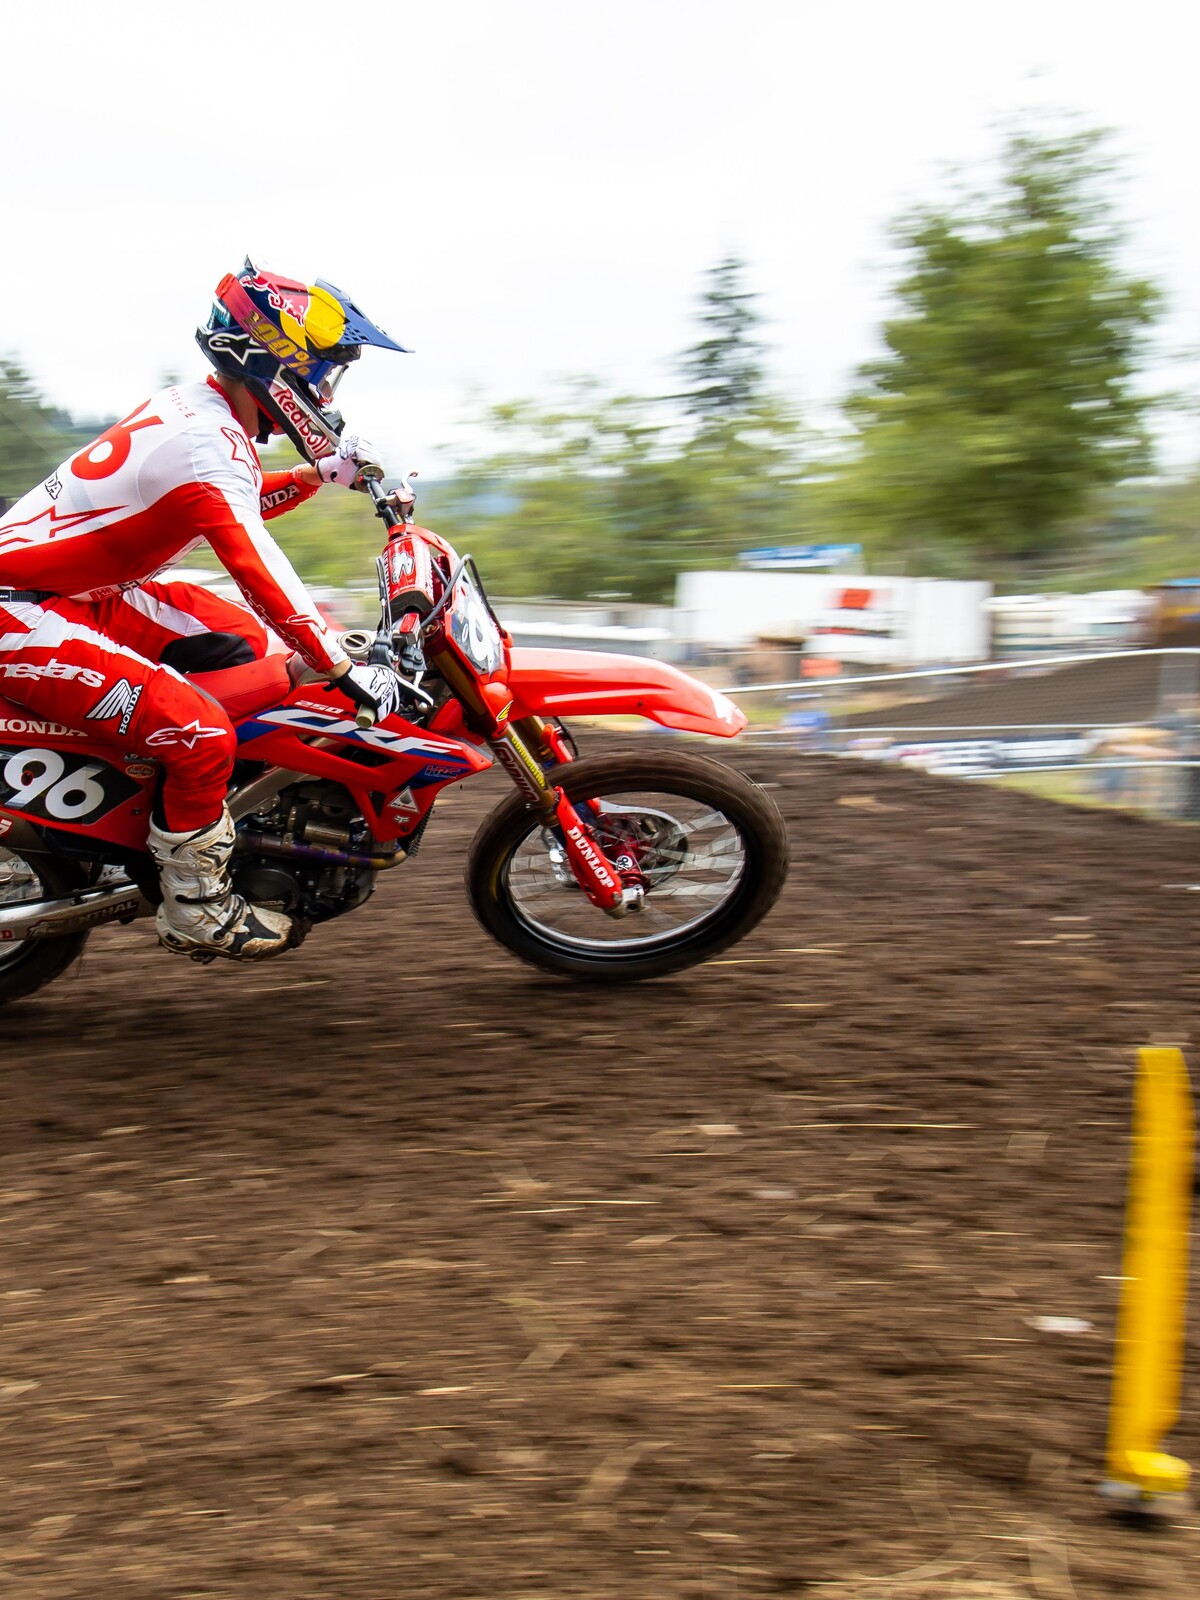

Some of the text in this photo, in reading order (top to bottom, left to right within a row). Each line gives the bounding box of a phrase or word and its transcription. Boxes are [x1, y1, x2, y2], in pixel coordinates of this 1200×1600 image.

[274, 389, 311, 429] Red
[71, 399, 164, 481] 6
[260, 484, 301, 512] NDA
[119, 684, 142, 735] HONDA
[294, 700, 344, 714] 250
[3, 748, 105, 819] 96
[566, 825, 615, 888] DUNLOP
